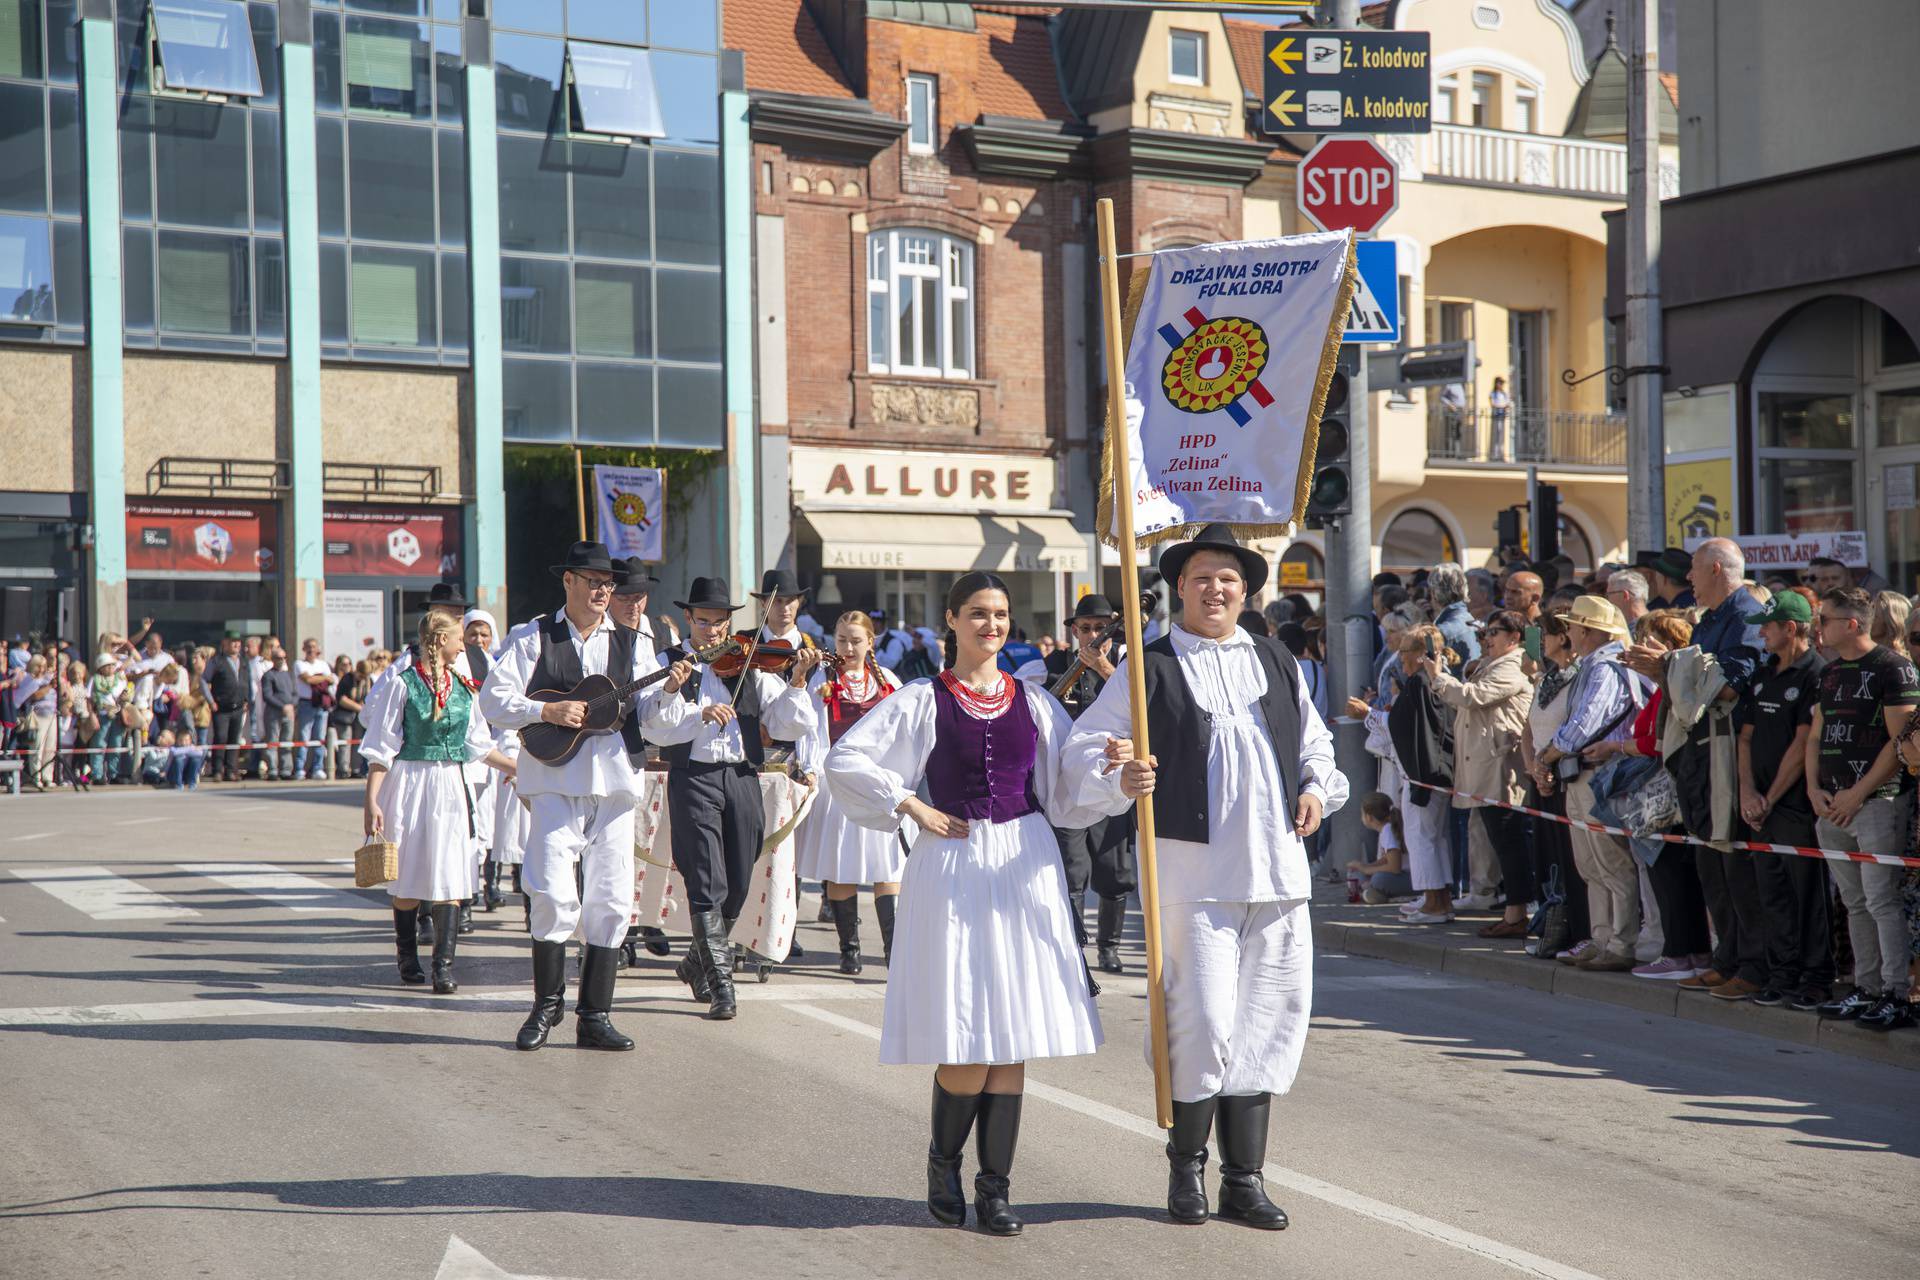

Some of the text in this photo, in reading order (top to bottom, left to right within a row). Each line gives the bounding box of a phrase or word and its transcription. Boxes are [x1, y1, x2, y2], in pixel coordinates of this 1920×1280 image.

[1343, 41, 1427, 69] Ž. kolodvor
[1343, 96, 1429, 119] A. kolodvor
[1306, 167, 1391, 206] STOP
[1170, 259, 1320, 285] DRŽAVNA SMOTRA
[1198, 280, 1283, 299] FOLKLORA
[1198, 382, 1215, 391] LIX
[1179, 434, 1216, 450] HPD
[825, 464, 1031, 500] ALLURE
[1169, 479, 1203, 494] Ivan
[1208, 476, 1263, 493] Zelina
[834, 551, 905, 567] ALLURE
